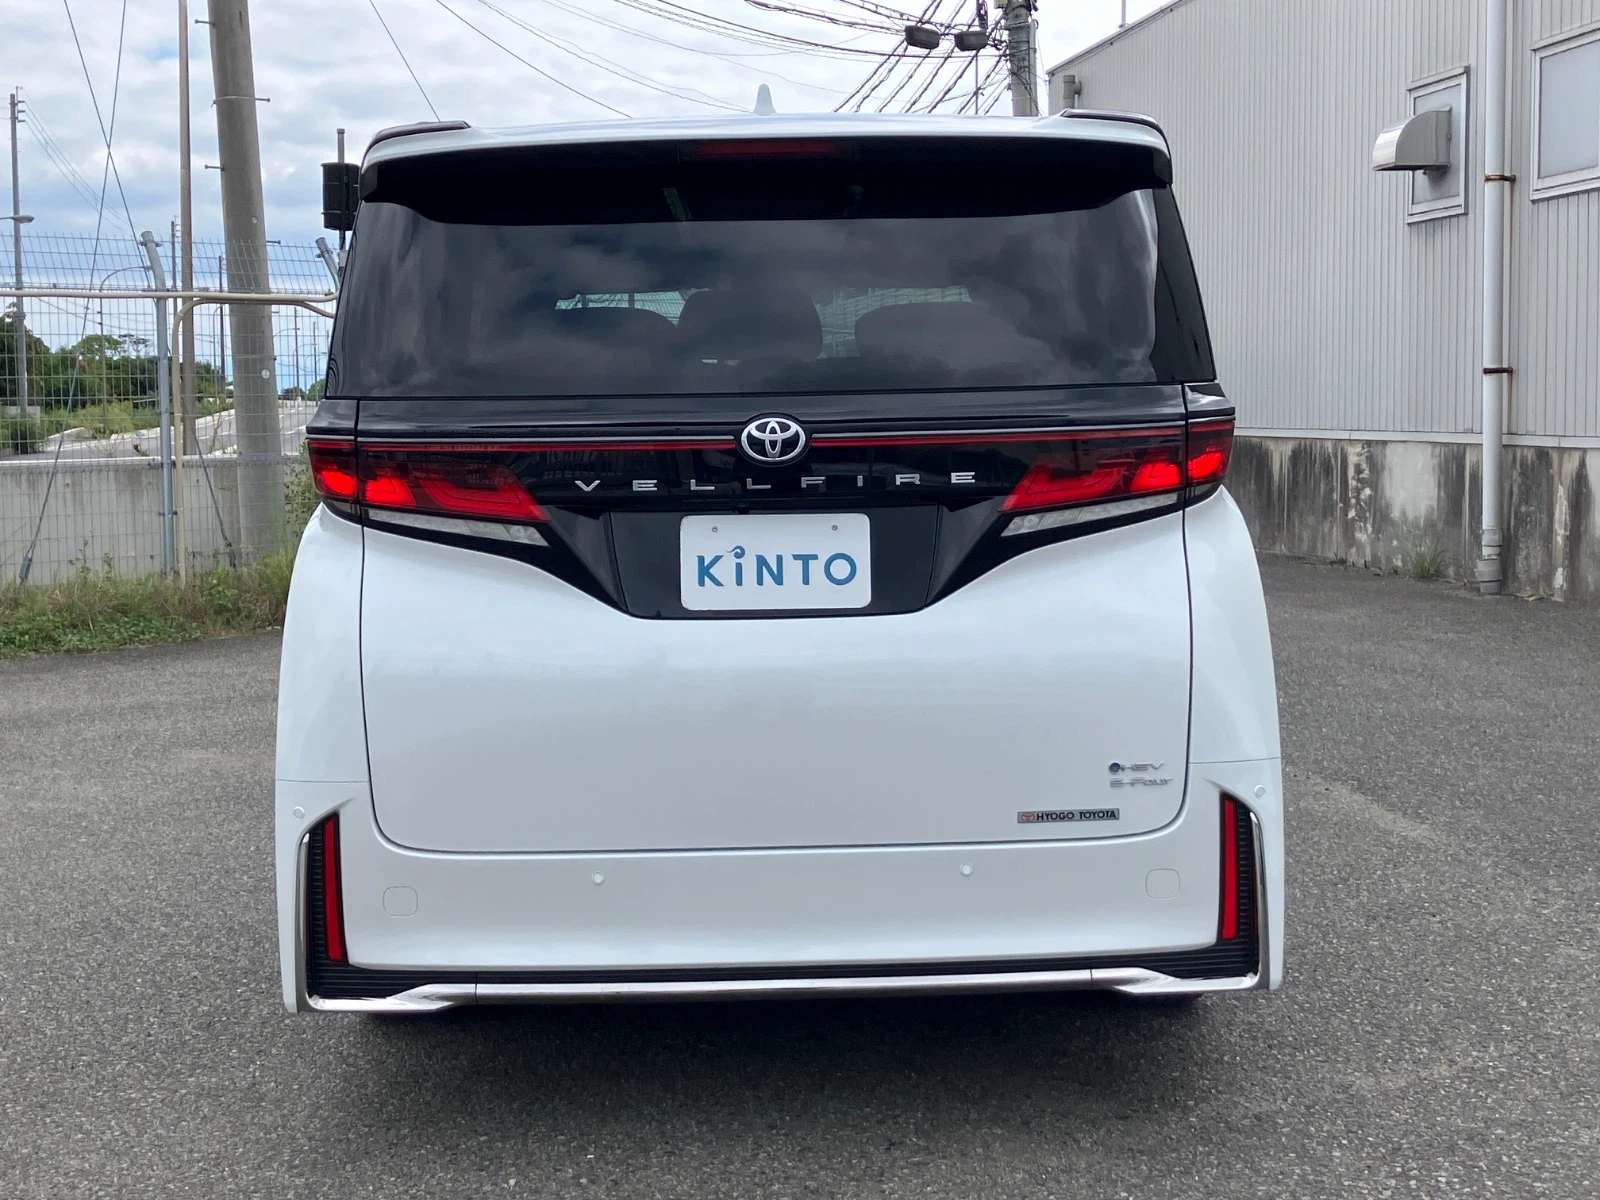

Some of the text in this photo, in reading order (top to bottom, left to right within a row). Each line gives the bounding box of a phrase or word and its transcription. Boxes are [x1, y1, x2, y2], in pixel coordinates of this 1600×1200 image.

[574, 471, 976, 492] VELLFIRE
[1036, 810, 1117, 821] HYOGO TOYOTA
